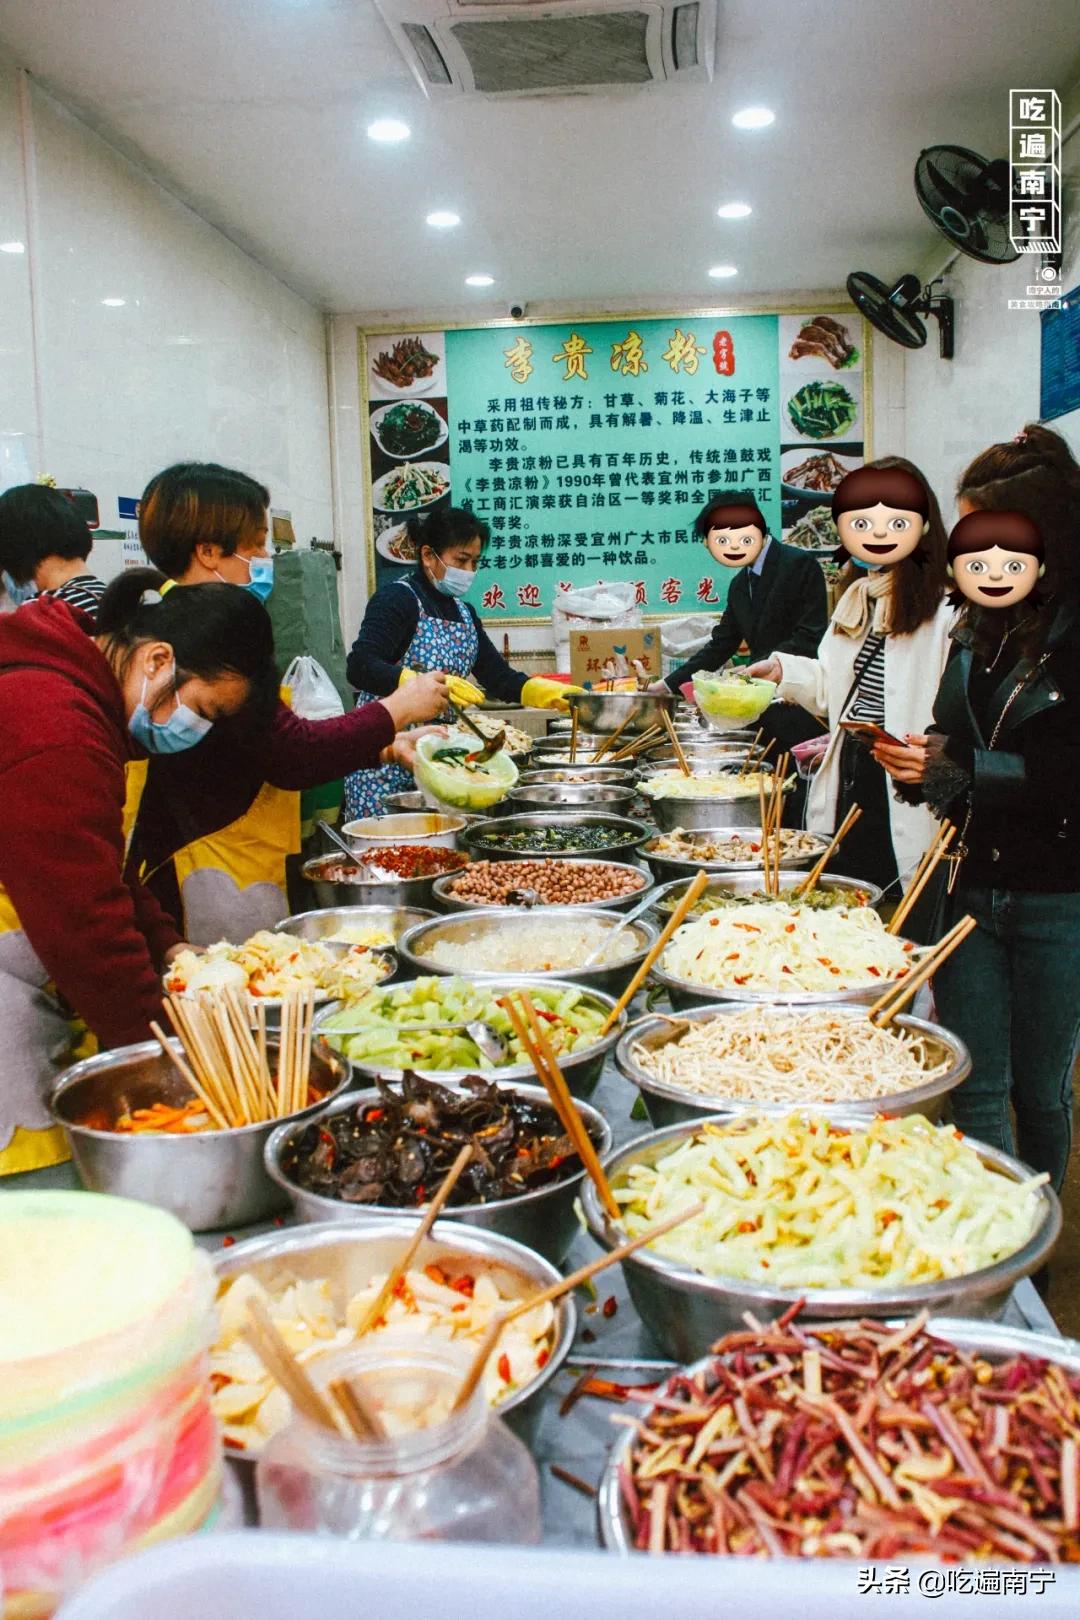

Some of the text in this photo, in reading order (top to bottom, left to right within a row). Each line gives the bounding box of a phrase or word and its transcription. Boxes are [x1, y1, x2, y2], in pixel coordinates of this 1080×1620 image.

[504, 329, 706, 383] 李贵凉粉
[461, 487, 772, 512] 省工商汇演荣获自治区一等奖和全汇
[491, 527, 771, 550] 李贵凉粉深受宜州广大市民的
